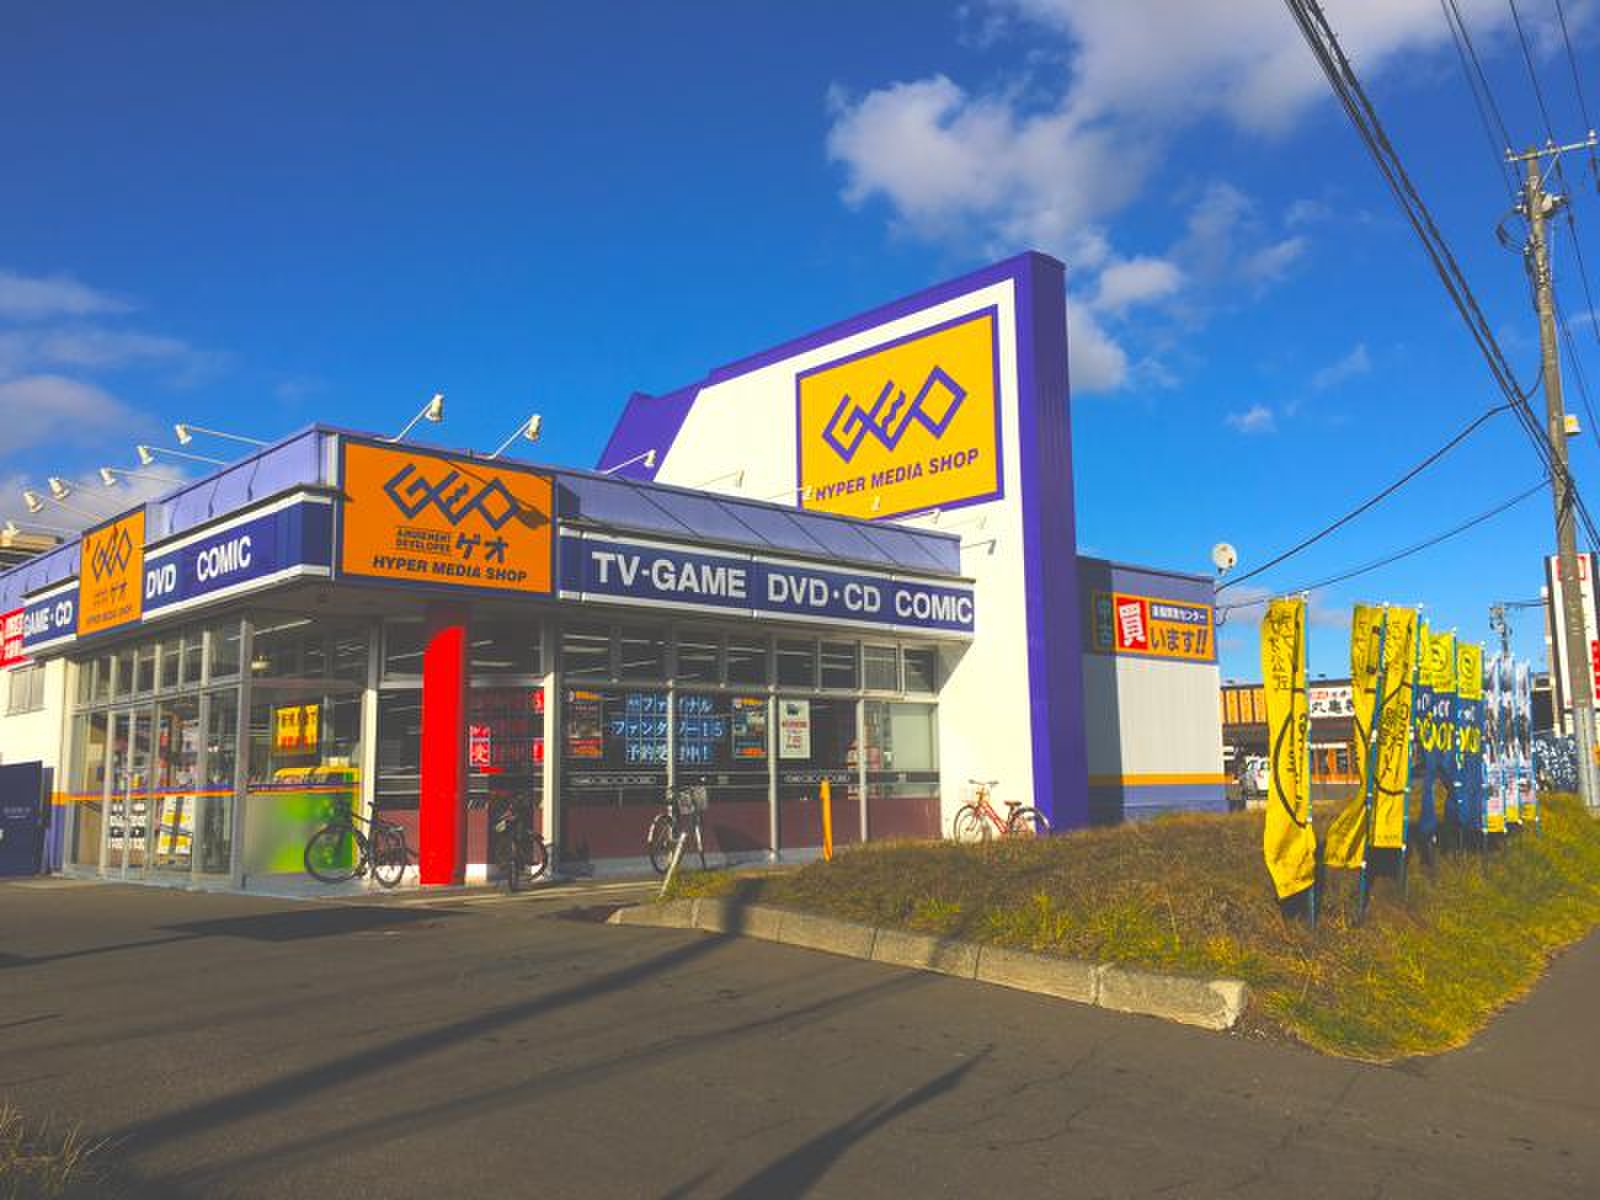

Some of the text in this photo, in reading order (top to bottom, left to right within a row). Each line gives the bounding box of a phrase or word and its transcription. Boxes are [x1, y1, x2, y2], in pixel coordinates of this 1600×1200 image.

[821, 364, 968, 464] GEO
[384, 463, 520, 530] GEO
[815, 447, 979, 502] HYPER MEDIA SHOP
[146, 563, 177, 599] DVD
[197, 535, 252, 581] COMIC
[373, 555, 528, 582] HYPER MEDIA SHOP
[456, 532, 509, 563] ゲオ
[895, 590, 974, 623] COMIC
[1119, 602, 1146, 647] 買
